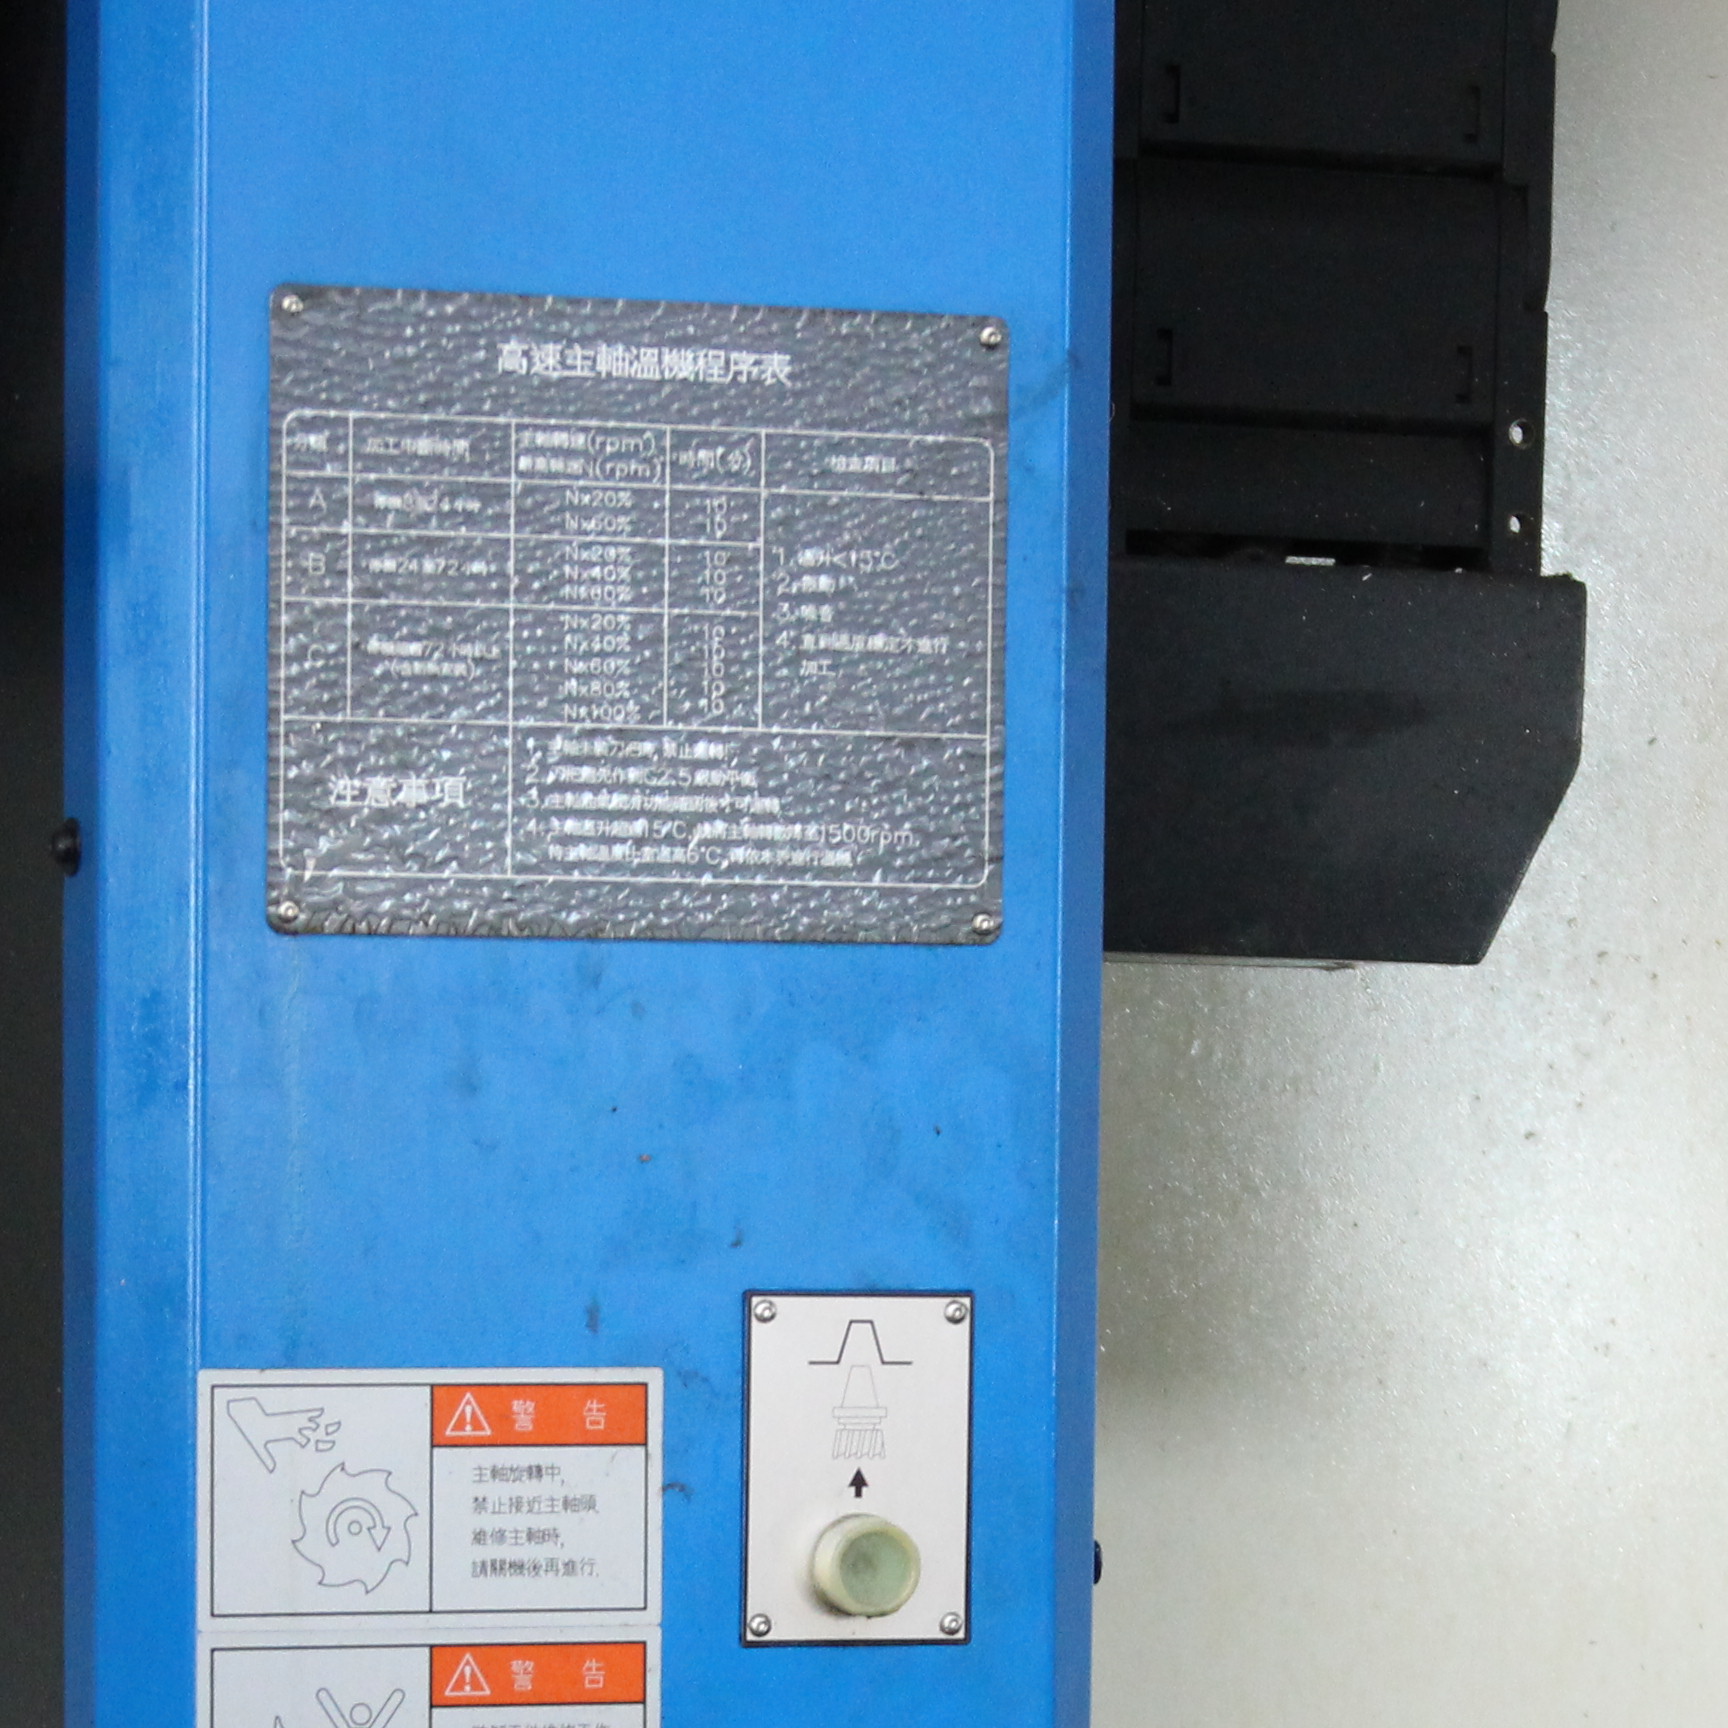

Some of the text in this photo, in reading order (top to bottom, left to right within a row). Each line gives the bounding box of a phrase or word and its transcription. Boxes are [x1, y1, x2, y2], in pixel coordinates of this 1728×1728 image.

[328, 772, 467, 809] 注意事項
[511, 1399, 607, 1431] 警告
[510, 1658, 605, 1691] 警告
